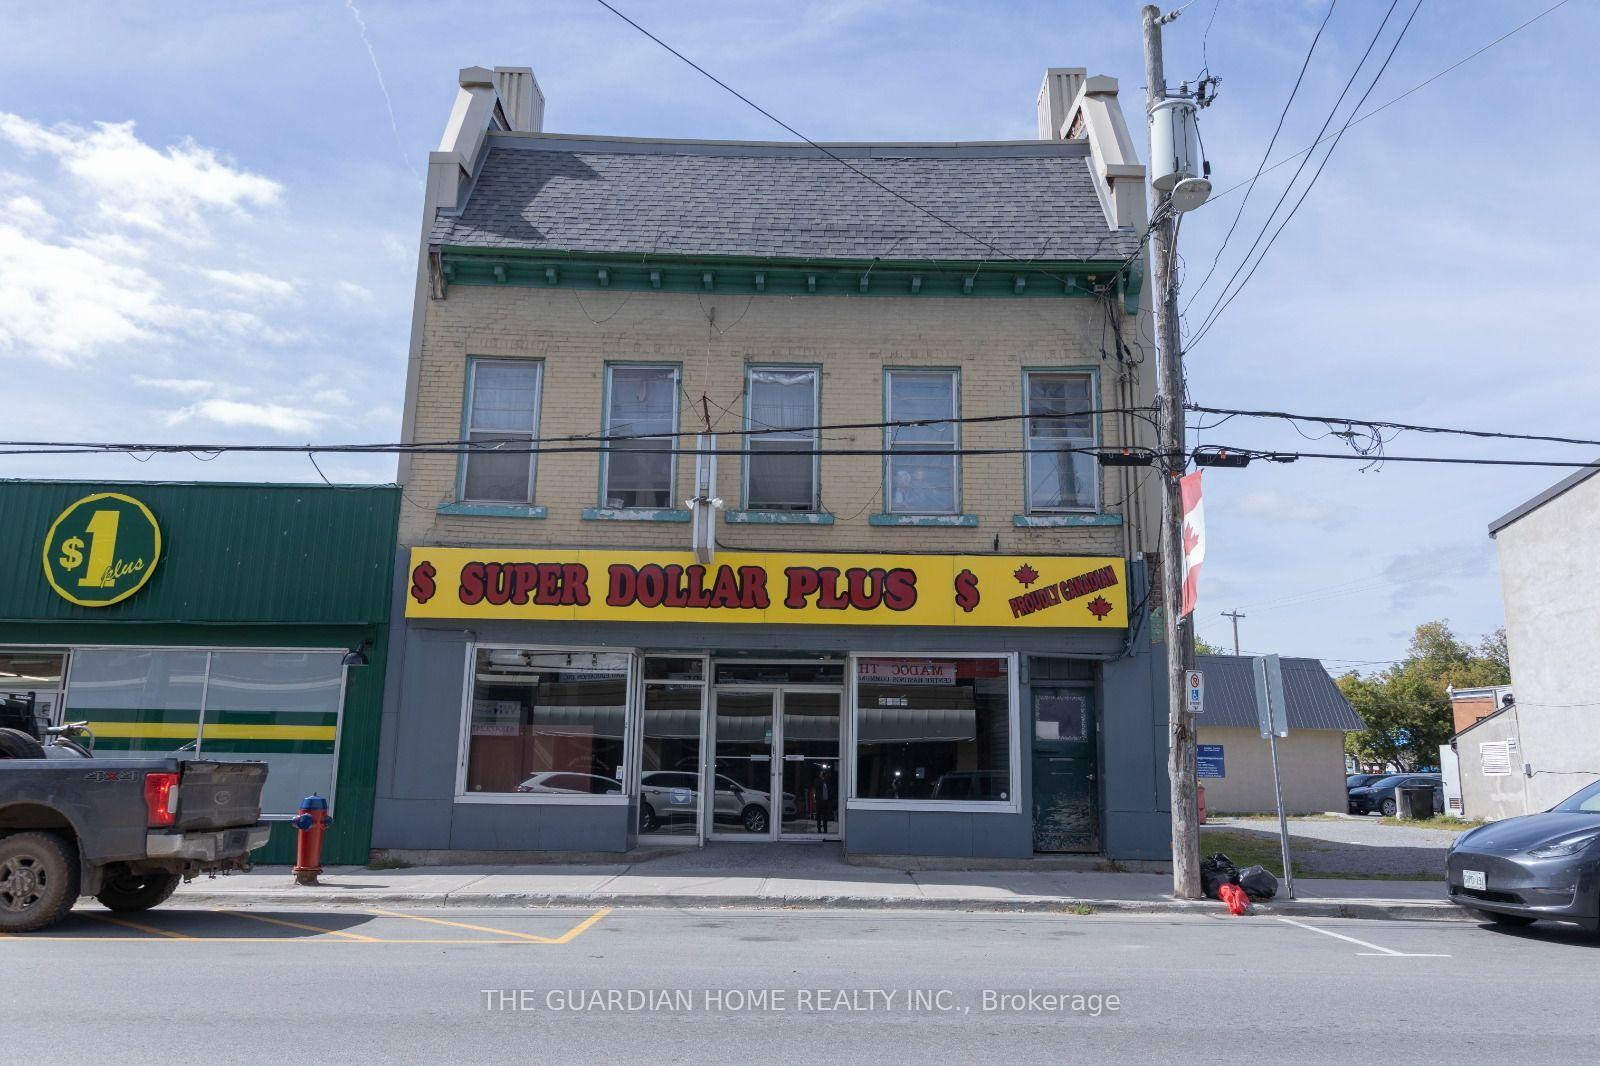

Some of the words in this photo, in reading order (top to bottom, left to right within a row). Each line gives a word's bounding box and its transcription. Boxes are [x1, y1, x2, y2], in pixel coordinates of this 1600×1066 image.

[101, 558, 144, 588] plus
[411, 560, 437, 605] $
[459, 561, 591, 606] SUPER
[606, 564, 770, 609] DOLLAR
[784, 567, 917, 611] PLUS
[954, 569, 980, 613] $
[1008, 583, 1061, 619] PROUDLY
[1059, 565, 1118, 601] CANADIAN
